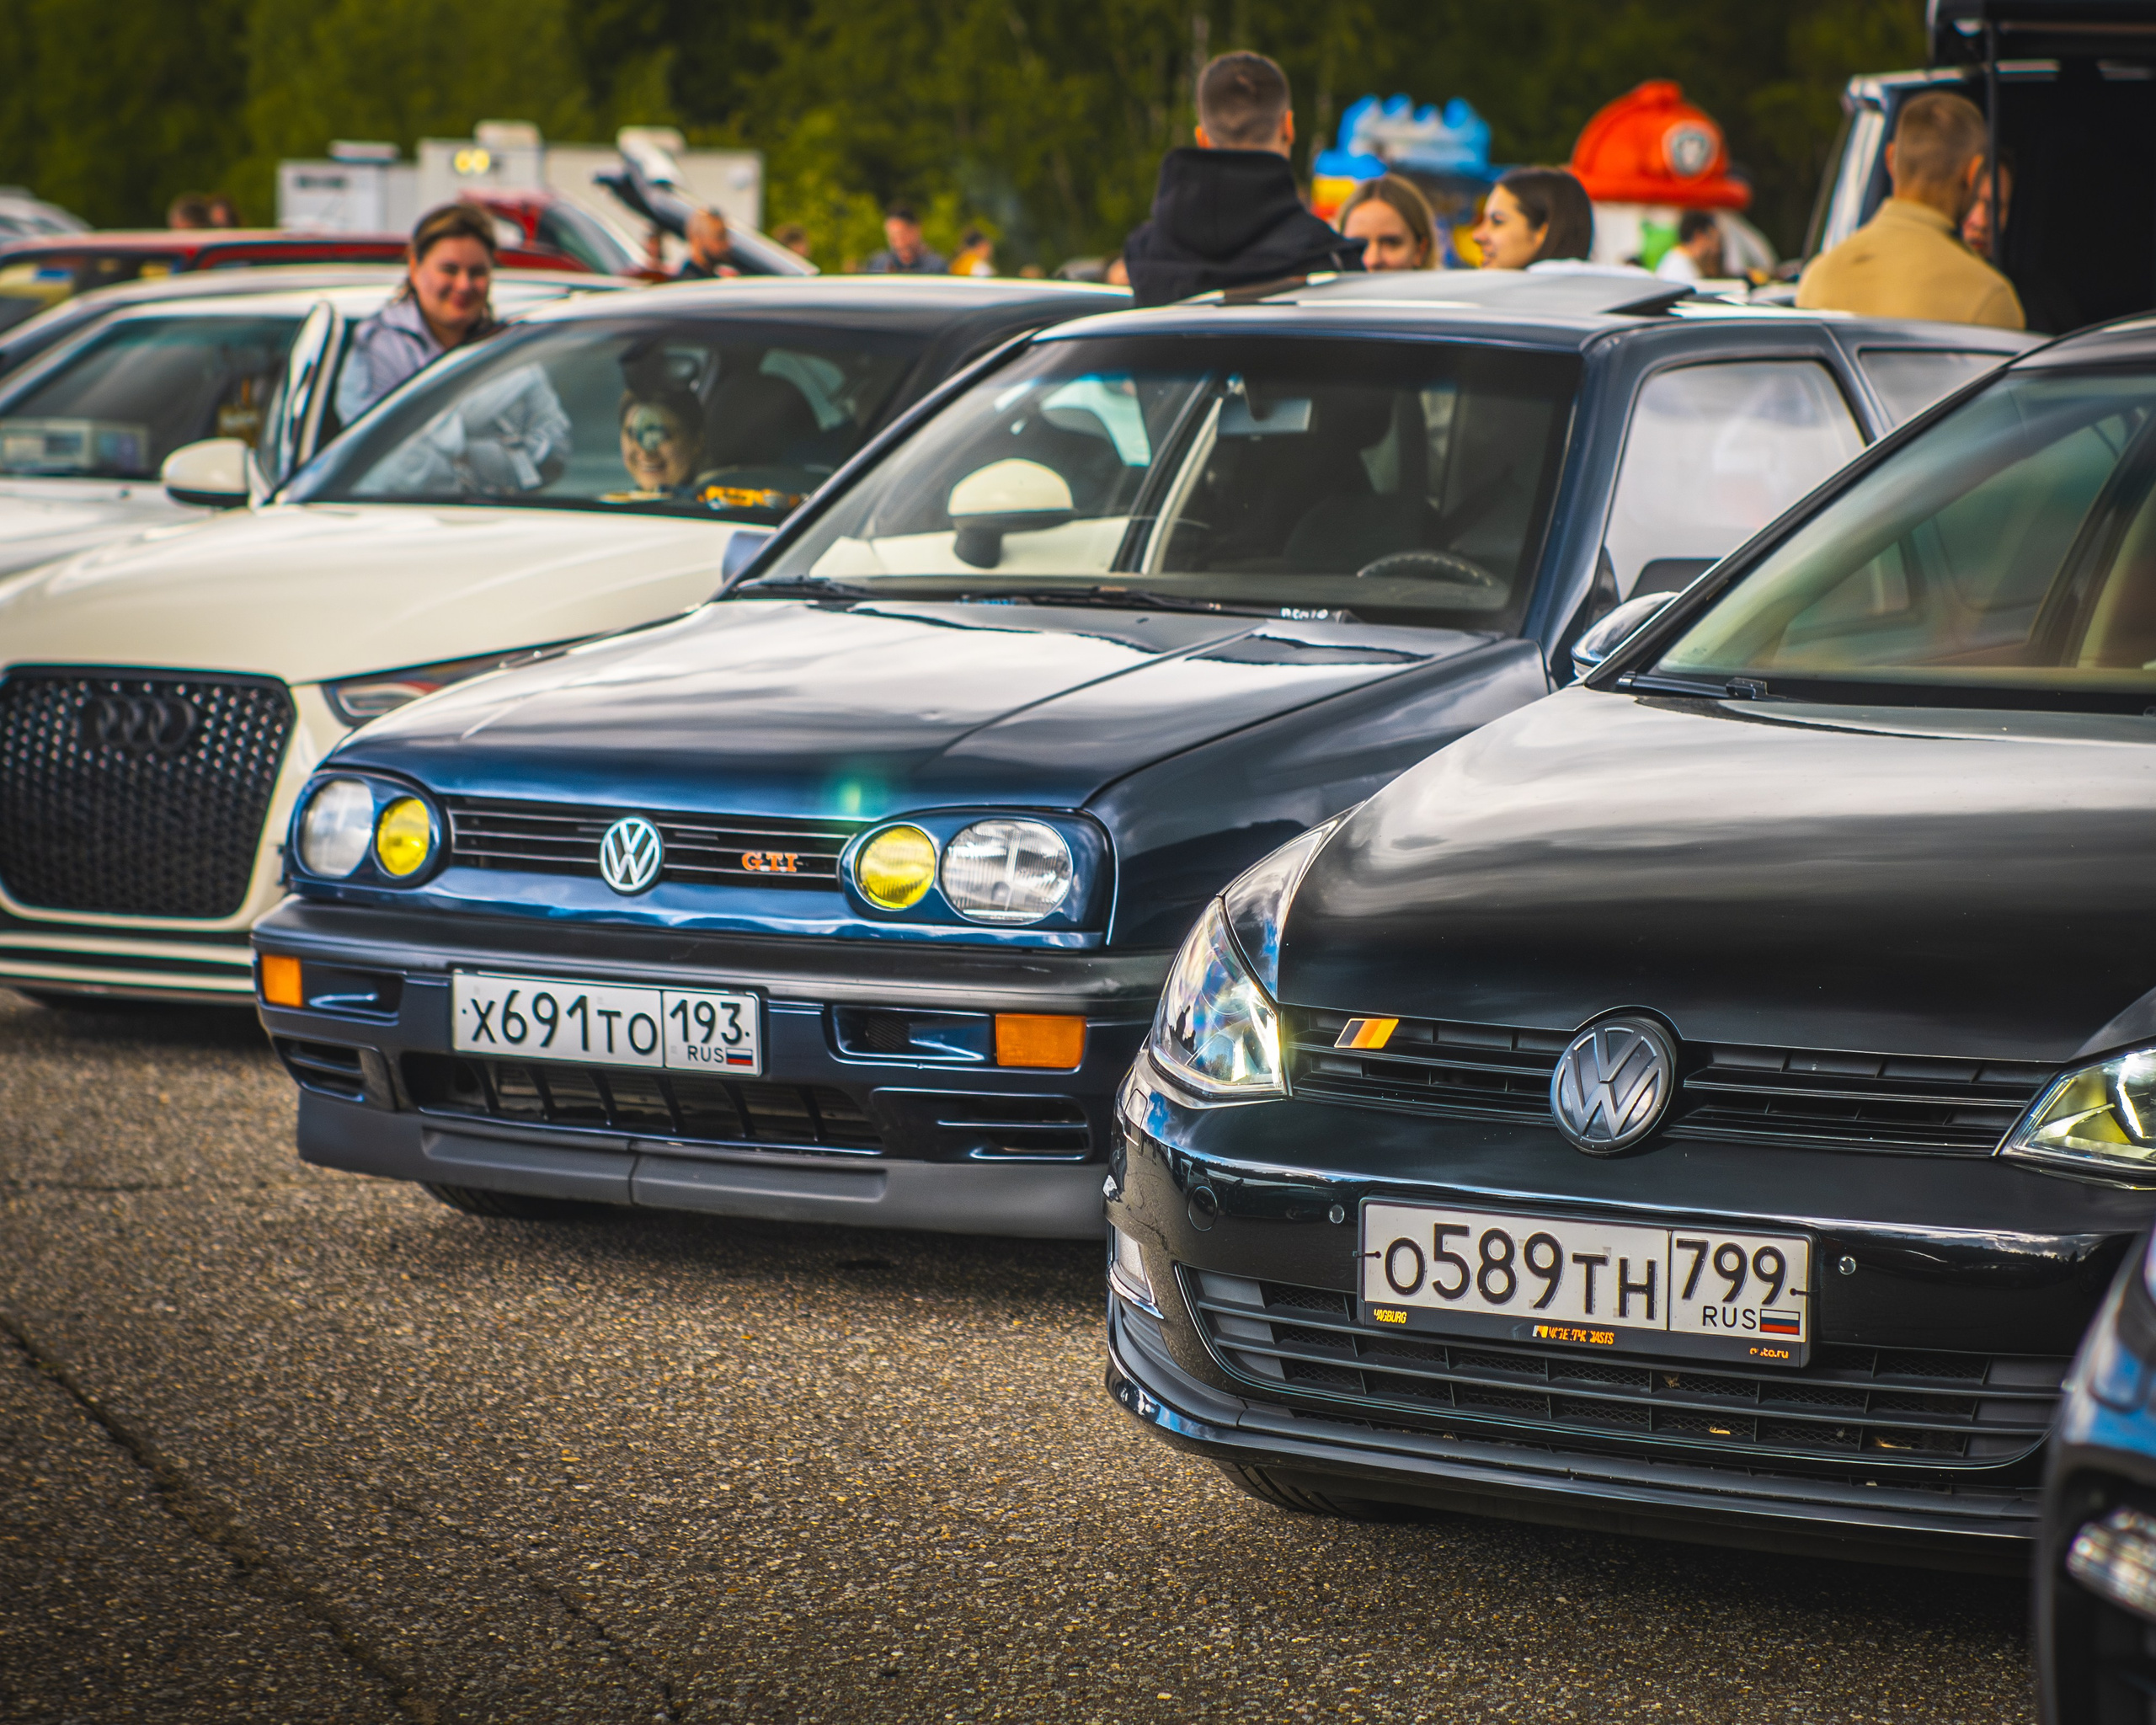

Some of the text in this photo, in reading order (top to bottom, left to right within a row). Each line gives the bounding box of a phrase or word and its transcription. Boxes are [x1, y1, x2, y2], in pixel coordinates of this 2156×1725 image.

[741, 851, 798, 873] GTI
[670, 999, 743, 1045] 193
[687, 1045, 724, 1064] RUS
[1676, 1237, 1788, 1306] 799
[1702, 1305, 1757, 1330] RUS
[1749, 1347, 1789, 1359] ato.ru
